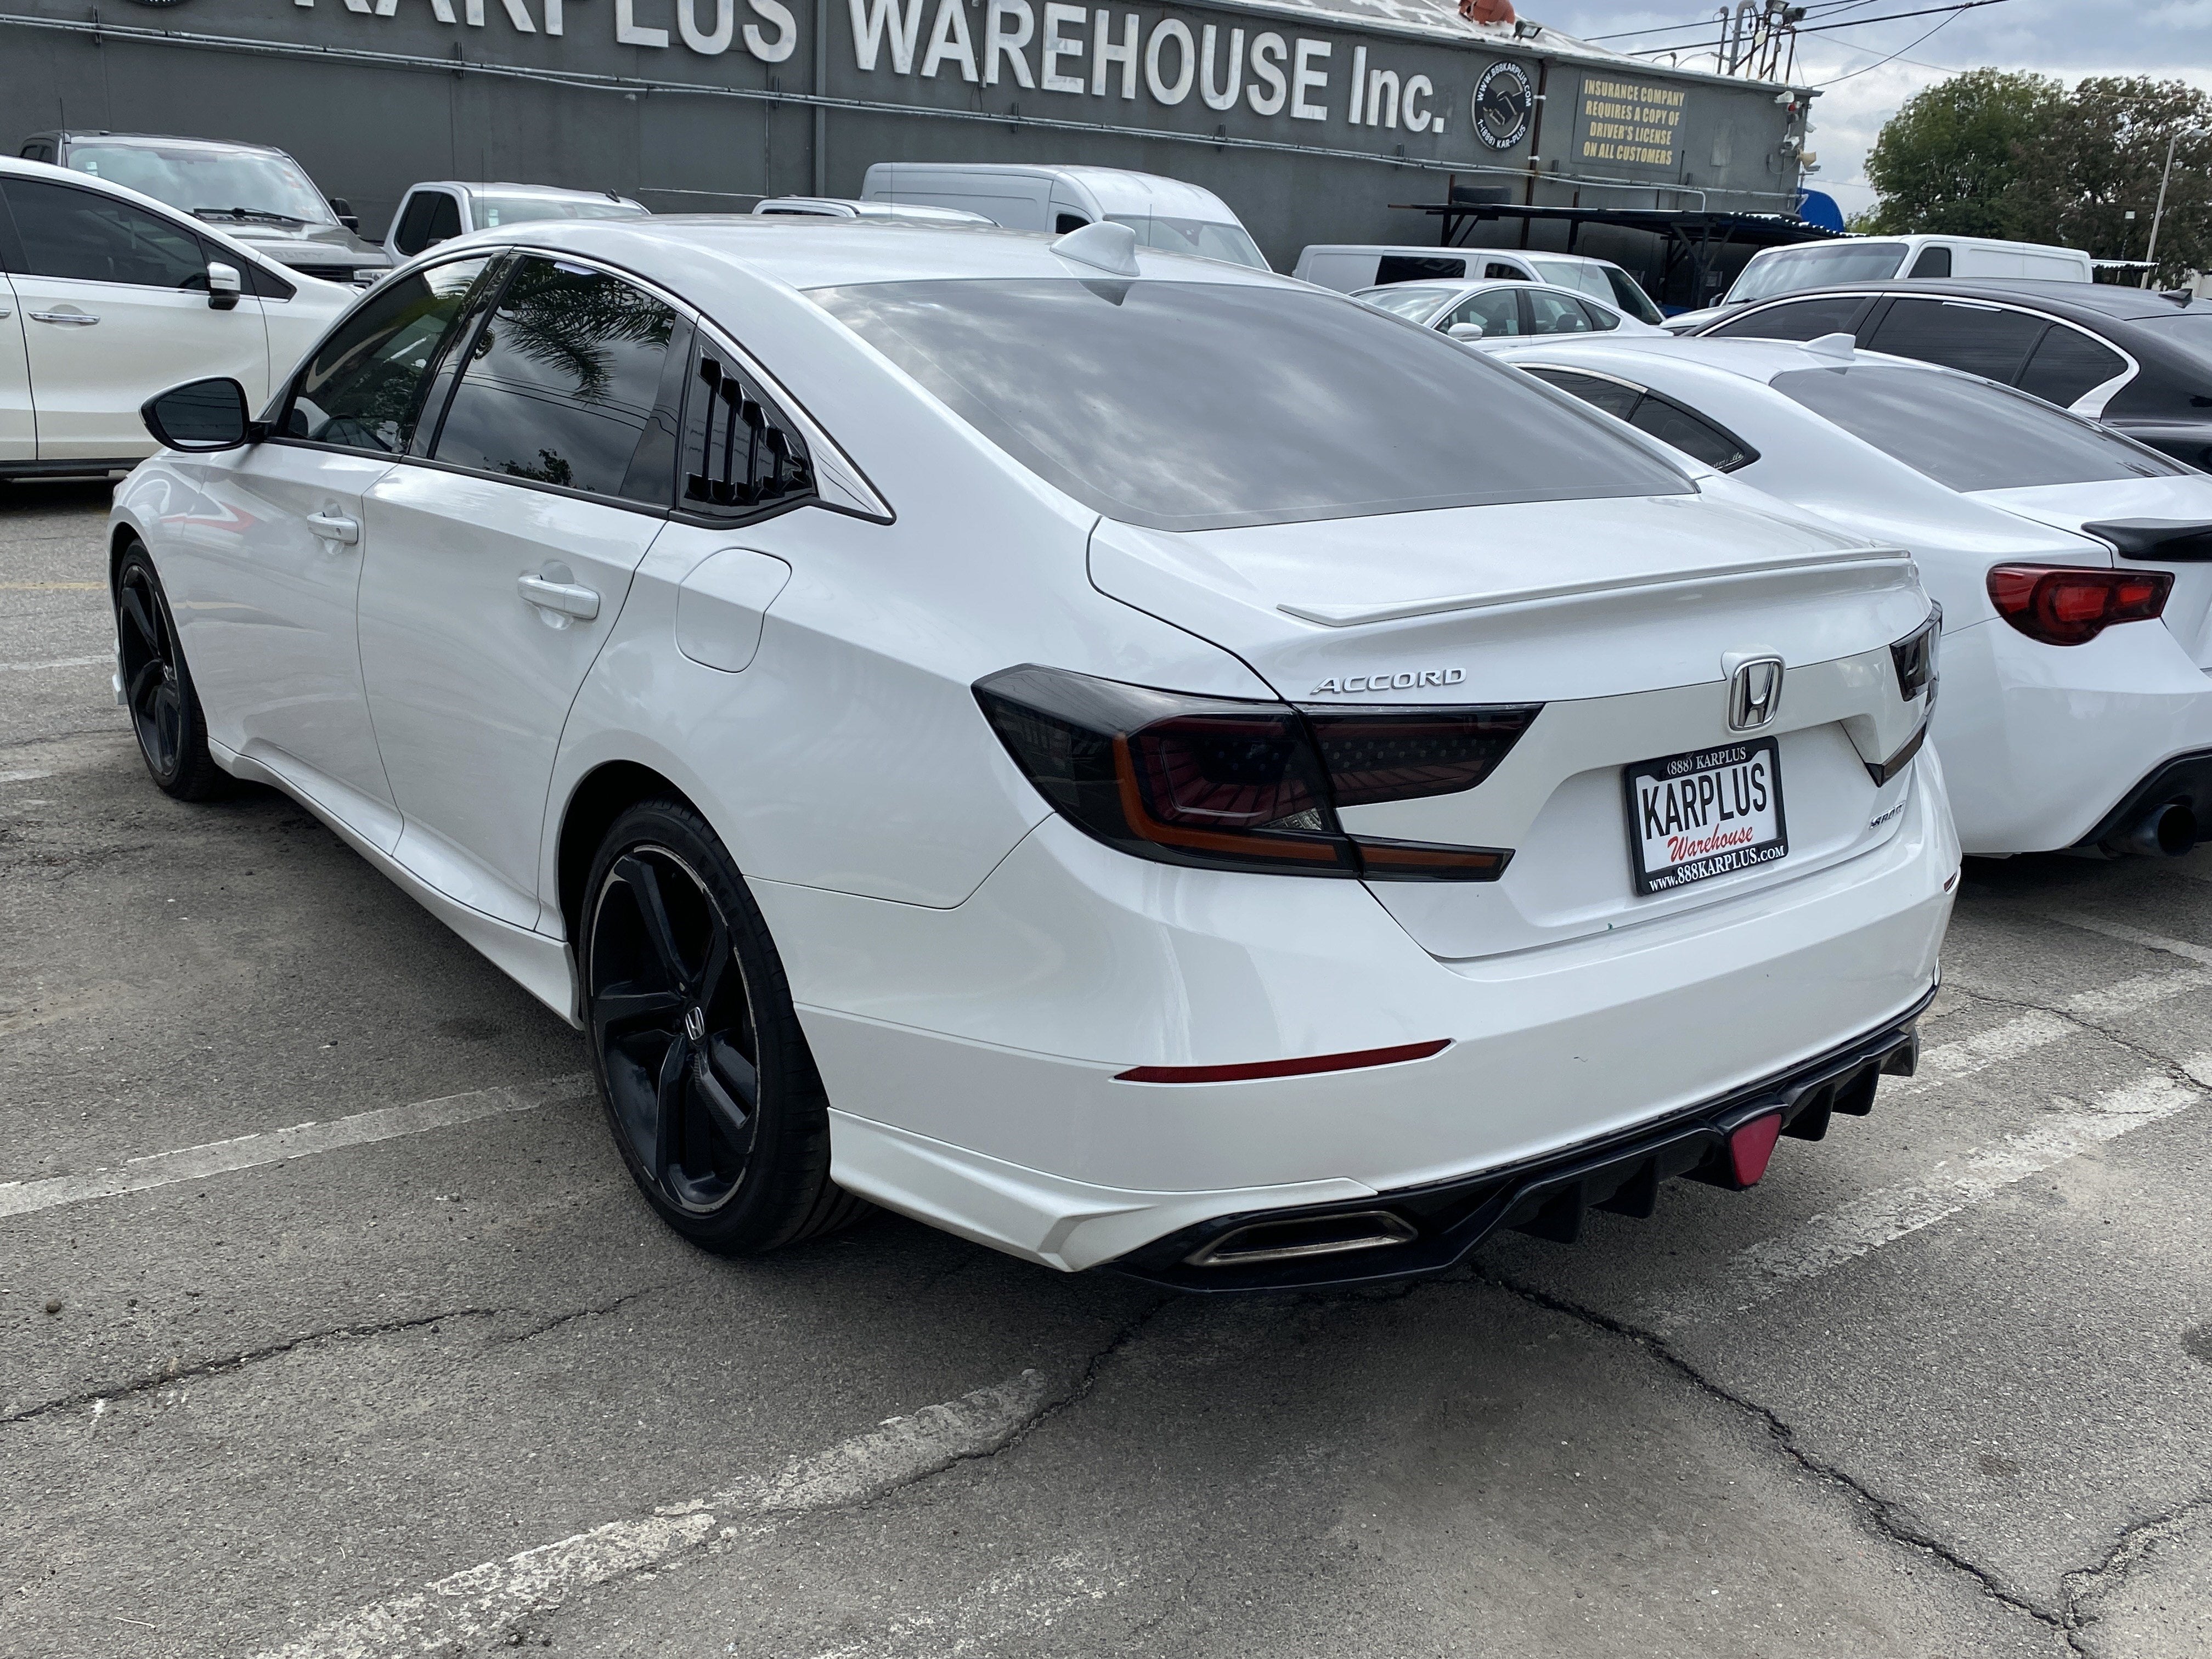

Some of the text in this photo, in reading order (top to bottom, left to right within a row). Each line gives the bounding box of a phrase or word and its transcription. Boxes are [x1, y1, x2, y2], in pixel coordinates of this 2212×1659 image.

[848, 0, 1332, 122] WAREHOUSE
[1347, 45, 1446, 134] Inc.
[1477, 63, 1531, 107] WWW.888KARPLUS.COM
[1584, 79, 1685, 106] INSURANCE COMPANY
[1585, 100, 1680, 126] REQUIRES A COPY OF
[1497, 125, 1526, 148] KAR-PLUS
[1589, 122, 1672, 145] DRIVER'S LICENSE
[1583, 142, 1672, 165] ON ALL CUSTOMERS
[1310, 667, 1466, 695] ACCORD
[1667, 747, 1746, 775] (888) KARPLUS
[1642, 763, 1767, 840] KARPLUS
[1667, 823, 1753, 862] Warehouse
